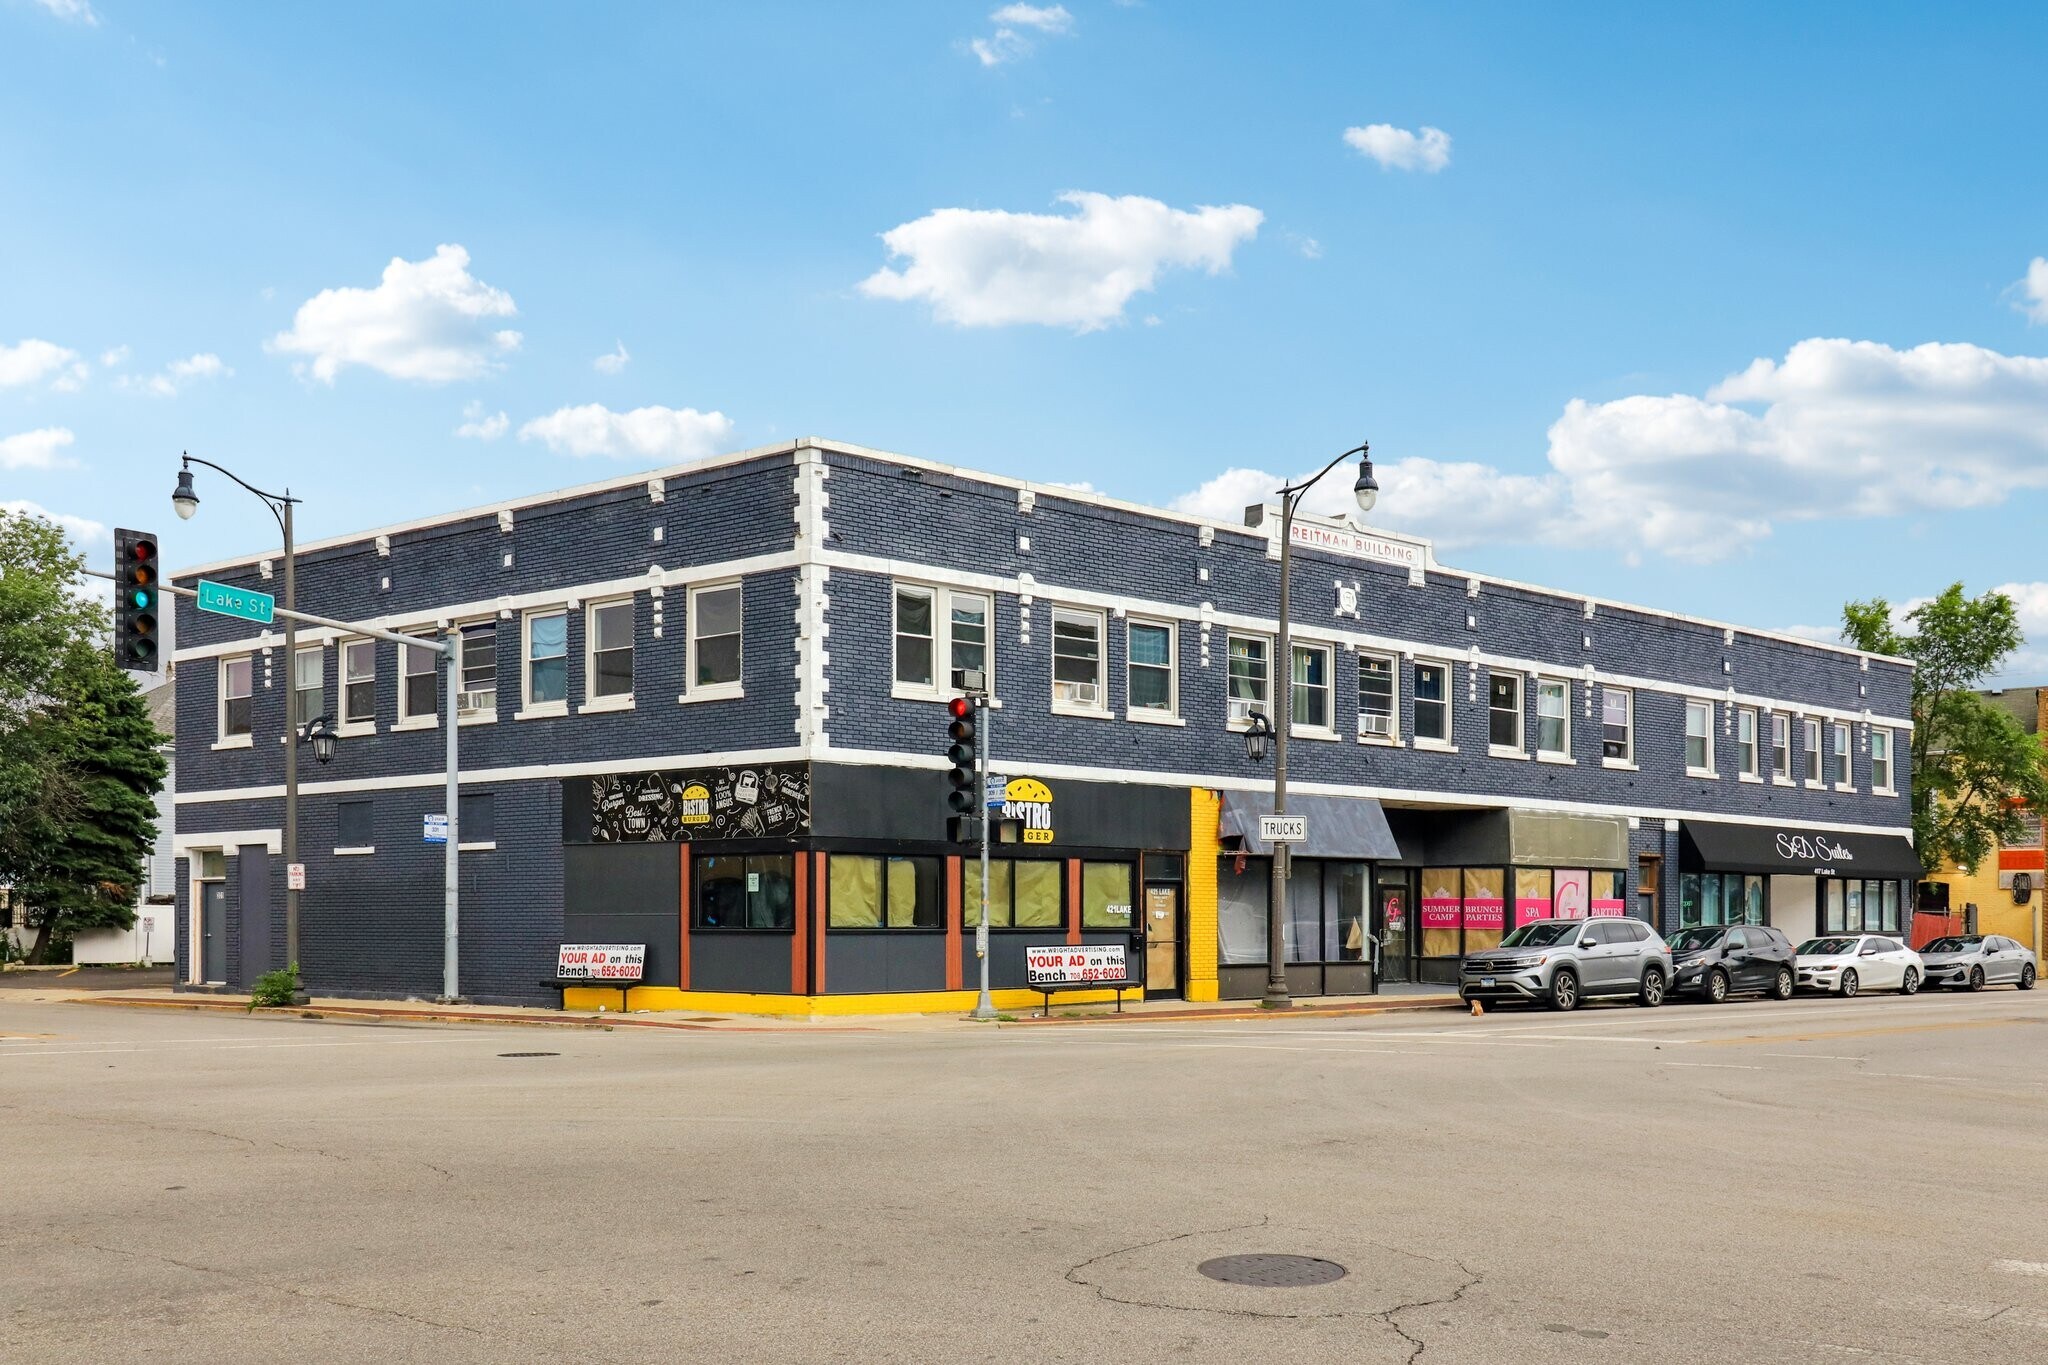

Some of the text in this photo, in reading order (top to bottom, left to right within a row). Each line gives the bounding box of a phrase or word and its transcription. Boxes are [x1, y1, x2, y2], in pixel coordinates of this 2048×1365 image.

[1292, 526, 1412, 560] REITMAN BUILDING
[205, 588, 266, 615] Lake St
[638, 793, 664, 802] DRESSING
[716, 797, 733, 810] ANGUS
[601, 798, 625, 812] Burger
[683, 799, 709, 816] BISTRO
[625, 805, 643, 818] Best
[628, 817, 646, 829] TOWN
[768, 812, 782, 824] FRIES
[1264, 822, 1302, 835] TRUCKS
[1815, 836, 1853, 861] Suites
[1422, 905, 1460, 913] SUMMER
[1465, 905, 1503, 913] BRUNCH
[1525, 907, 1540, 918] SPA
[1592, 907, 1623, 917] PARTIES
[1429, 913, 1454, 921] CAMP
[1466, 913, 1503, 921] PARTIES
[561, 952, 642, 964] YOUR AD on this
[1029, 955, 1125, 968] YOUR AD on this
[559, 965, 588, 976] Bench
[601, 965, 641, 977] 652-6020
[1029, 967, 1126, 981] Bench 708 652-6020
